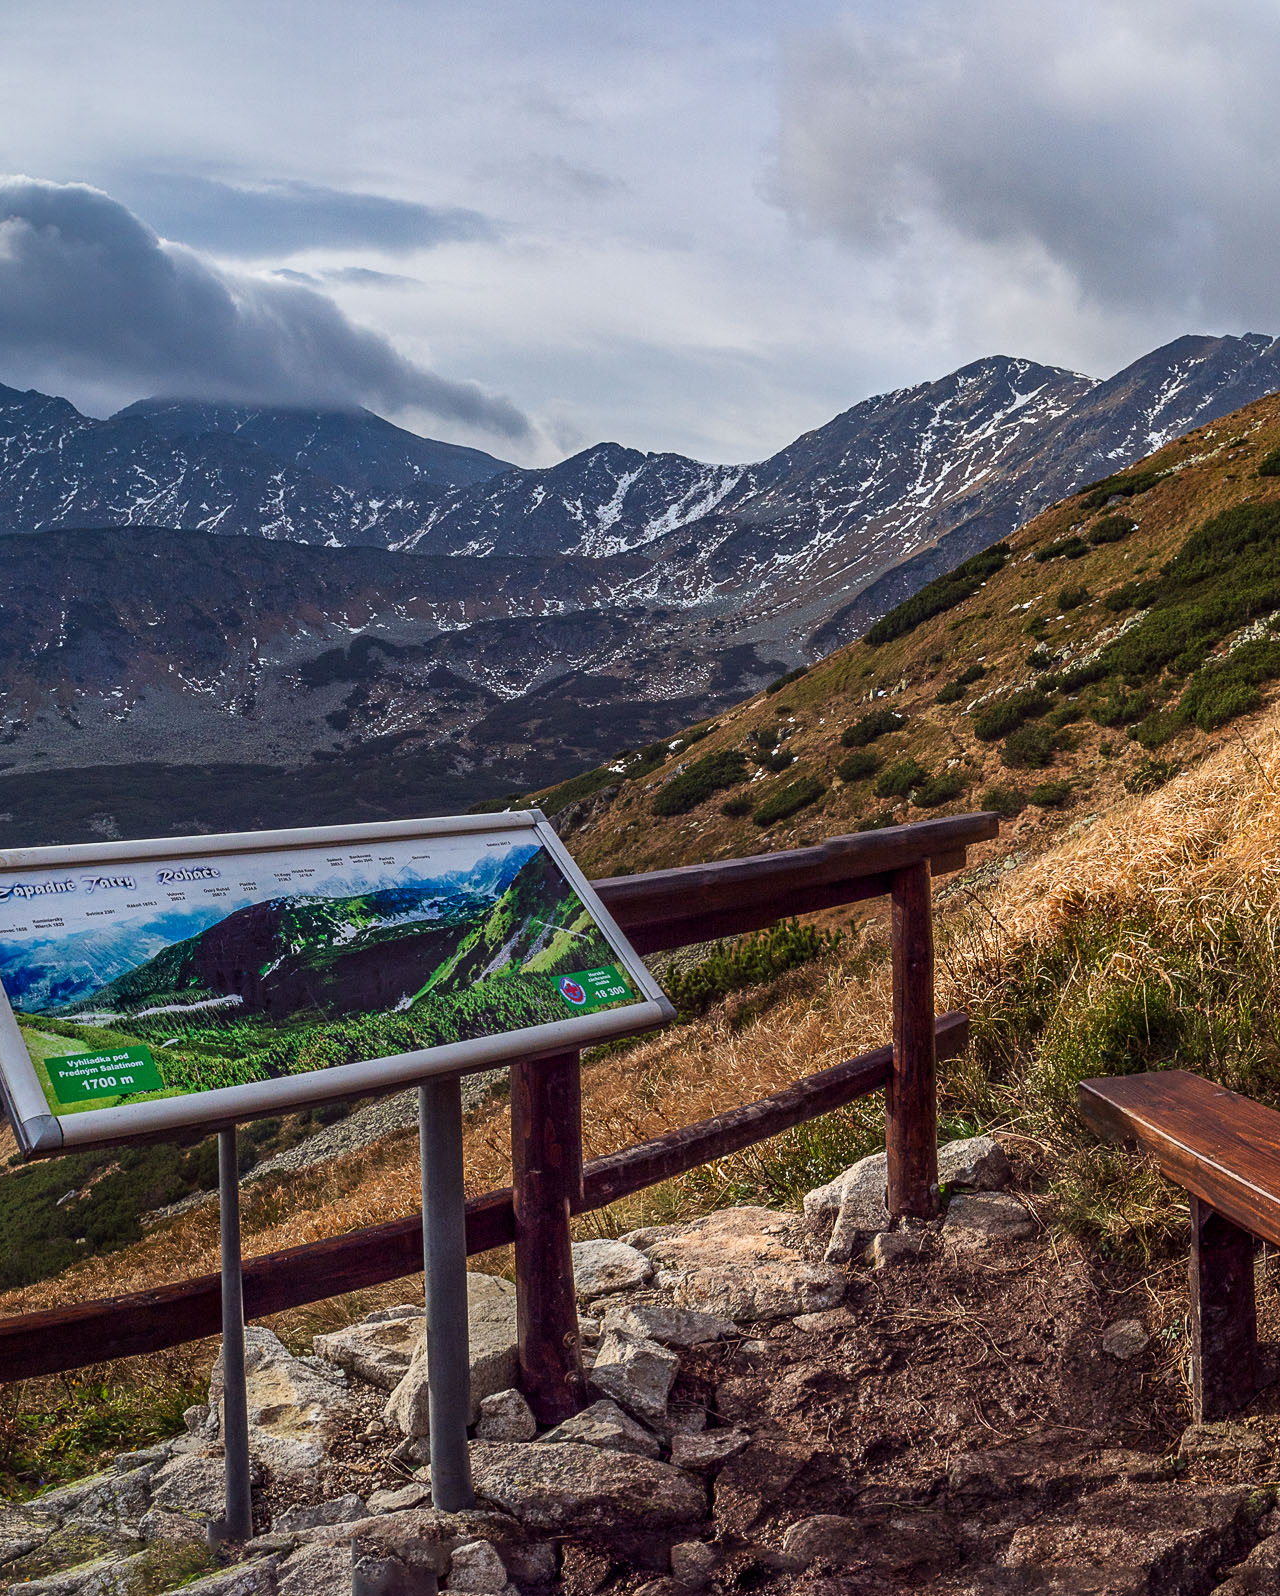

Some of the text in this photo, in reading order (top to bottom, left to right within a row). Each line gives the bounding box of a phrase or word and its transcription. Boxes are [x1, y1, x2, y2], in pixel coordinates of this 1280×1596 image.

[80, 875, 137, 894] Tatry
[157, 866, 220, 885] Roháče
[607, 986, 626, 996] 300
[66, 1052, 130, 1068] Vyhliadka pod
[59, 1067, 99, 1078] Predným
[81, 1075, 135, 1090] 1700 m
